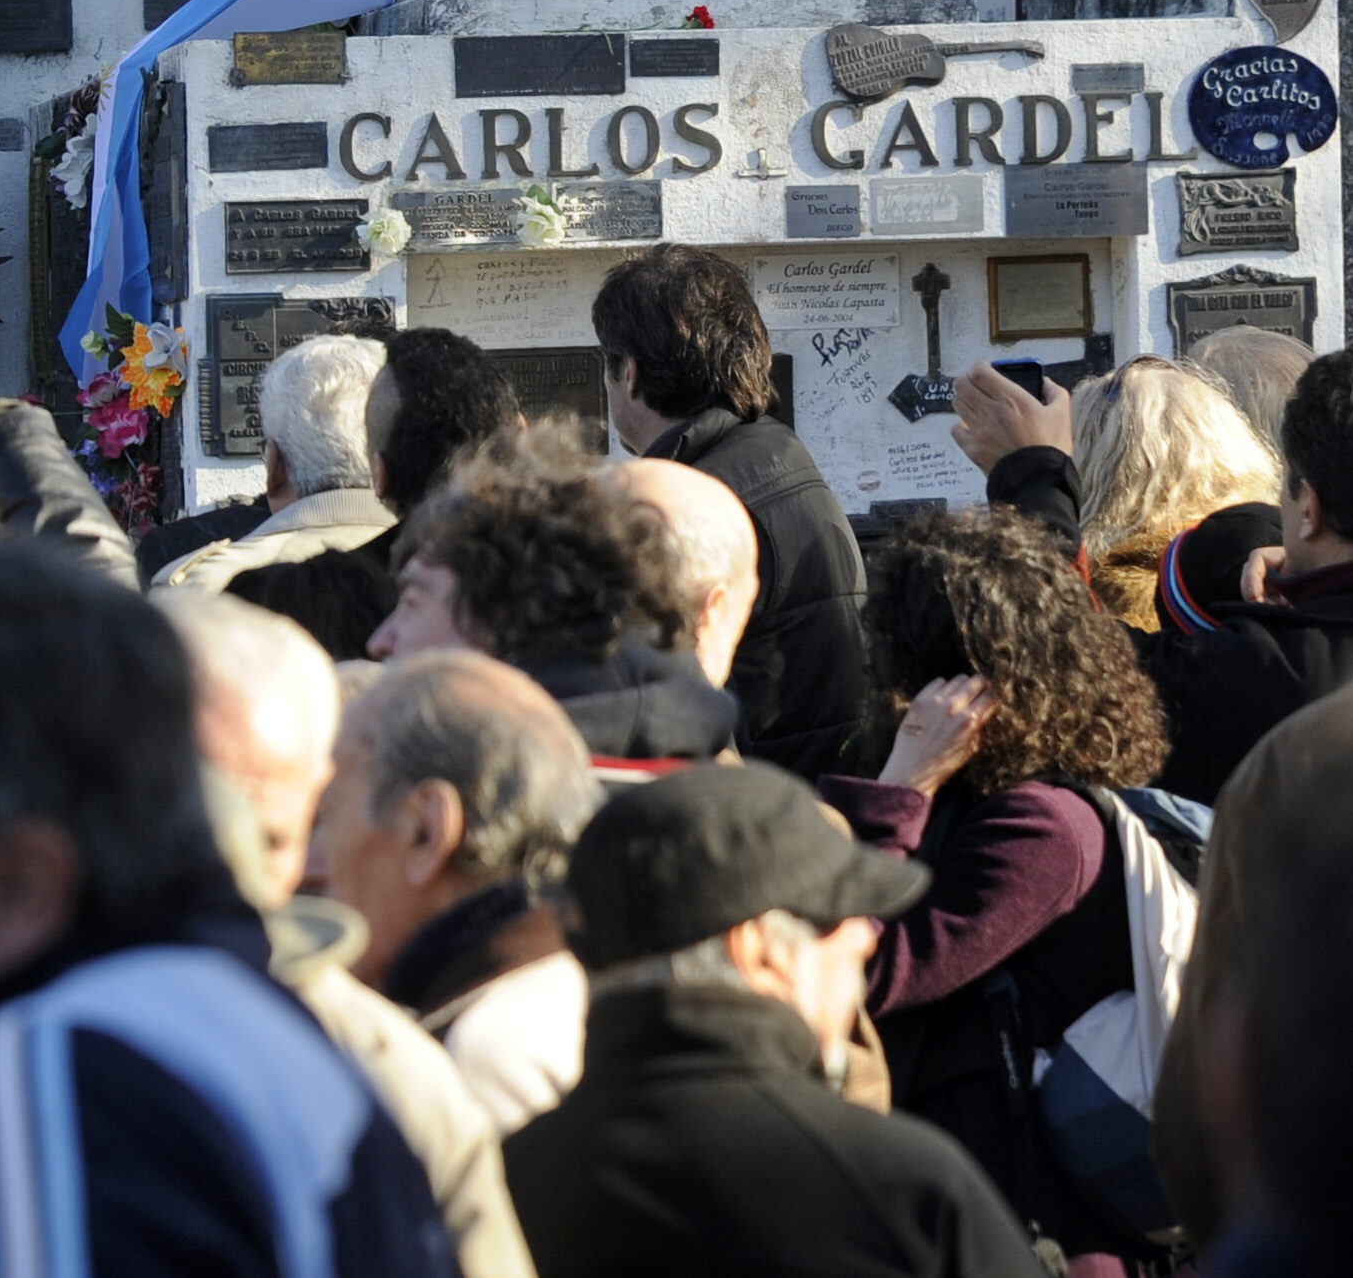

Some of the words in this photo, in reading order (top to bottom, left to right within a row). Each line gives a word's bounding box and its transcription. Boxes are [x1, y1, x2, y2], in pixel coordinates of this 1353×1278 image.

[1202, 56, 1299, 99] Gracias
[1226, 78, 1321, 111] Carlitos
[338, 102, 724, 182] CARLOS
[810, 89, 1197, 171] GARDEL
[434, 193, 497, 205] GARDEL
[783, 261, 825, 278] Carlos
[828, 259, 875, 280] Gardel
[782, 281, 830, 296] homenaje
[832, 280, 844, 293] de
